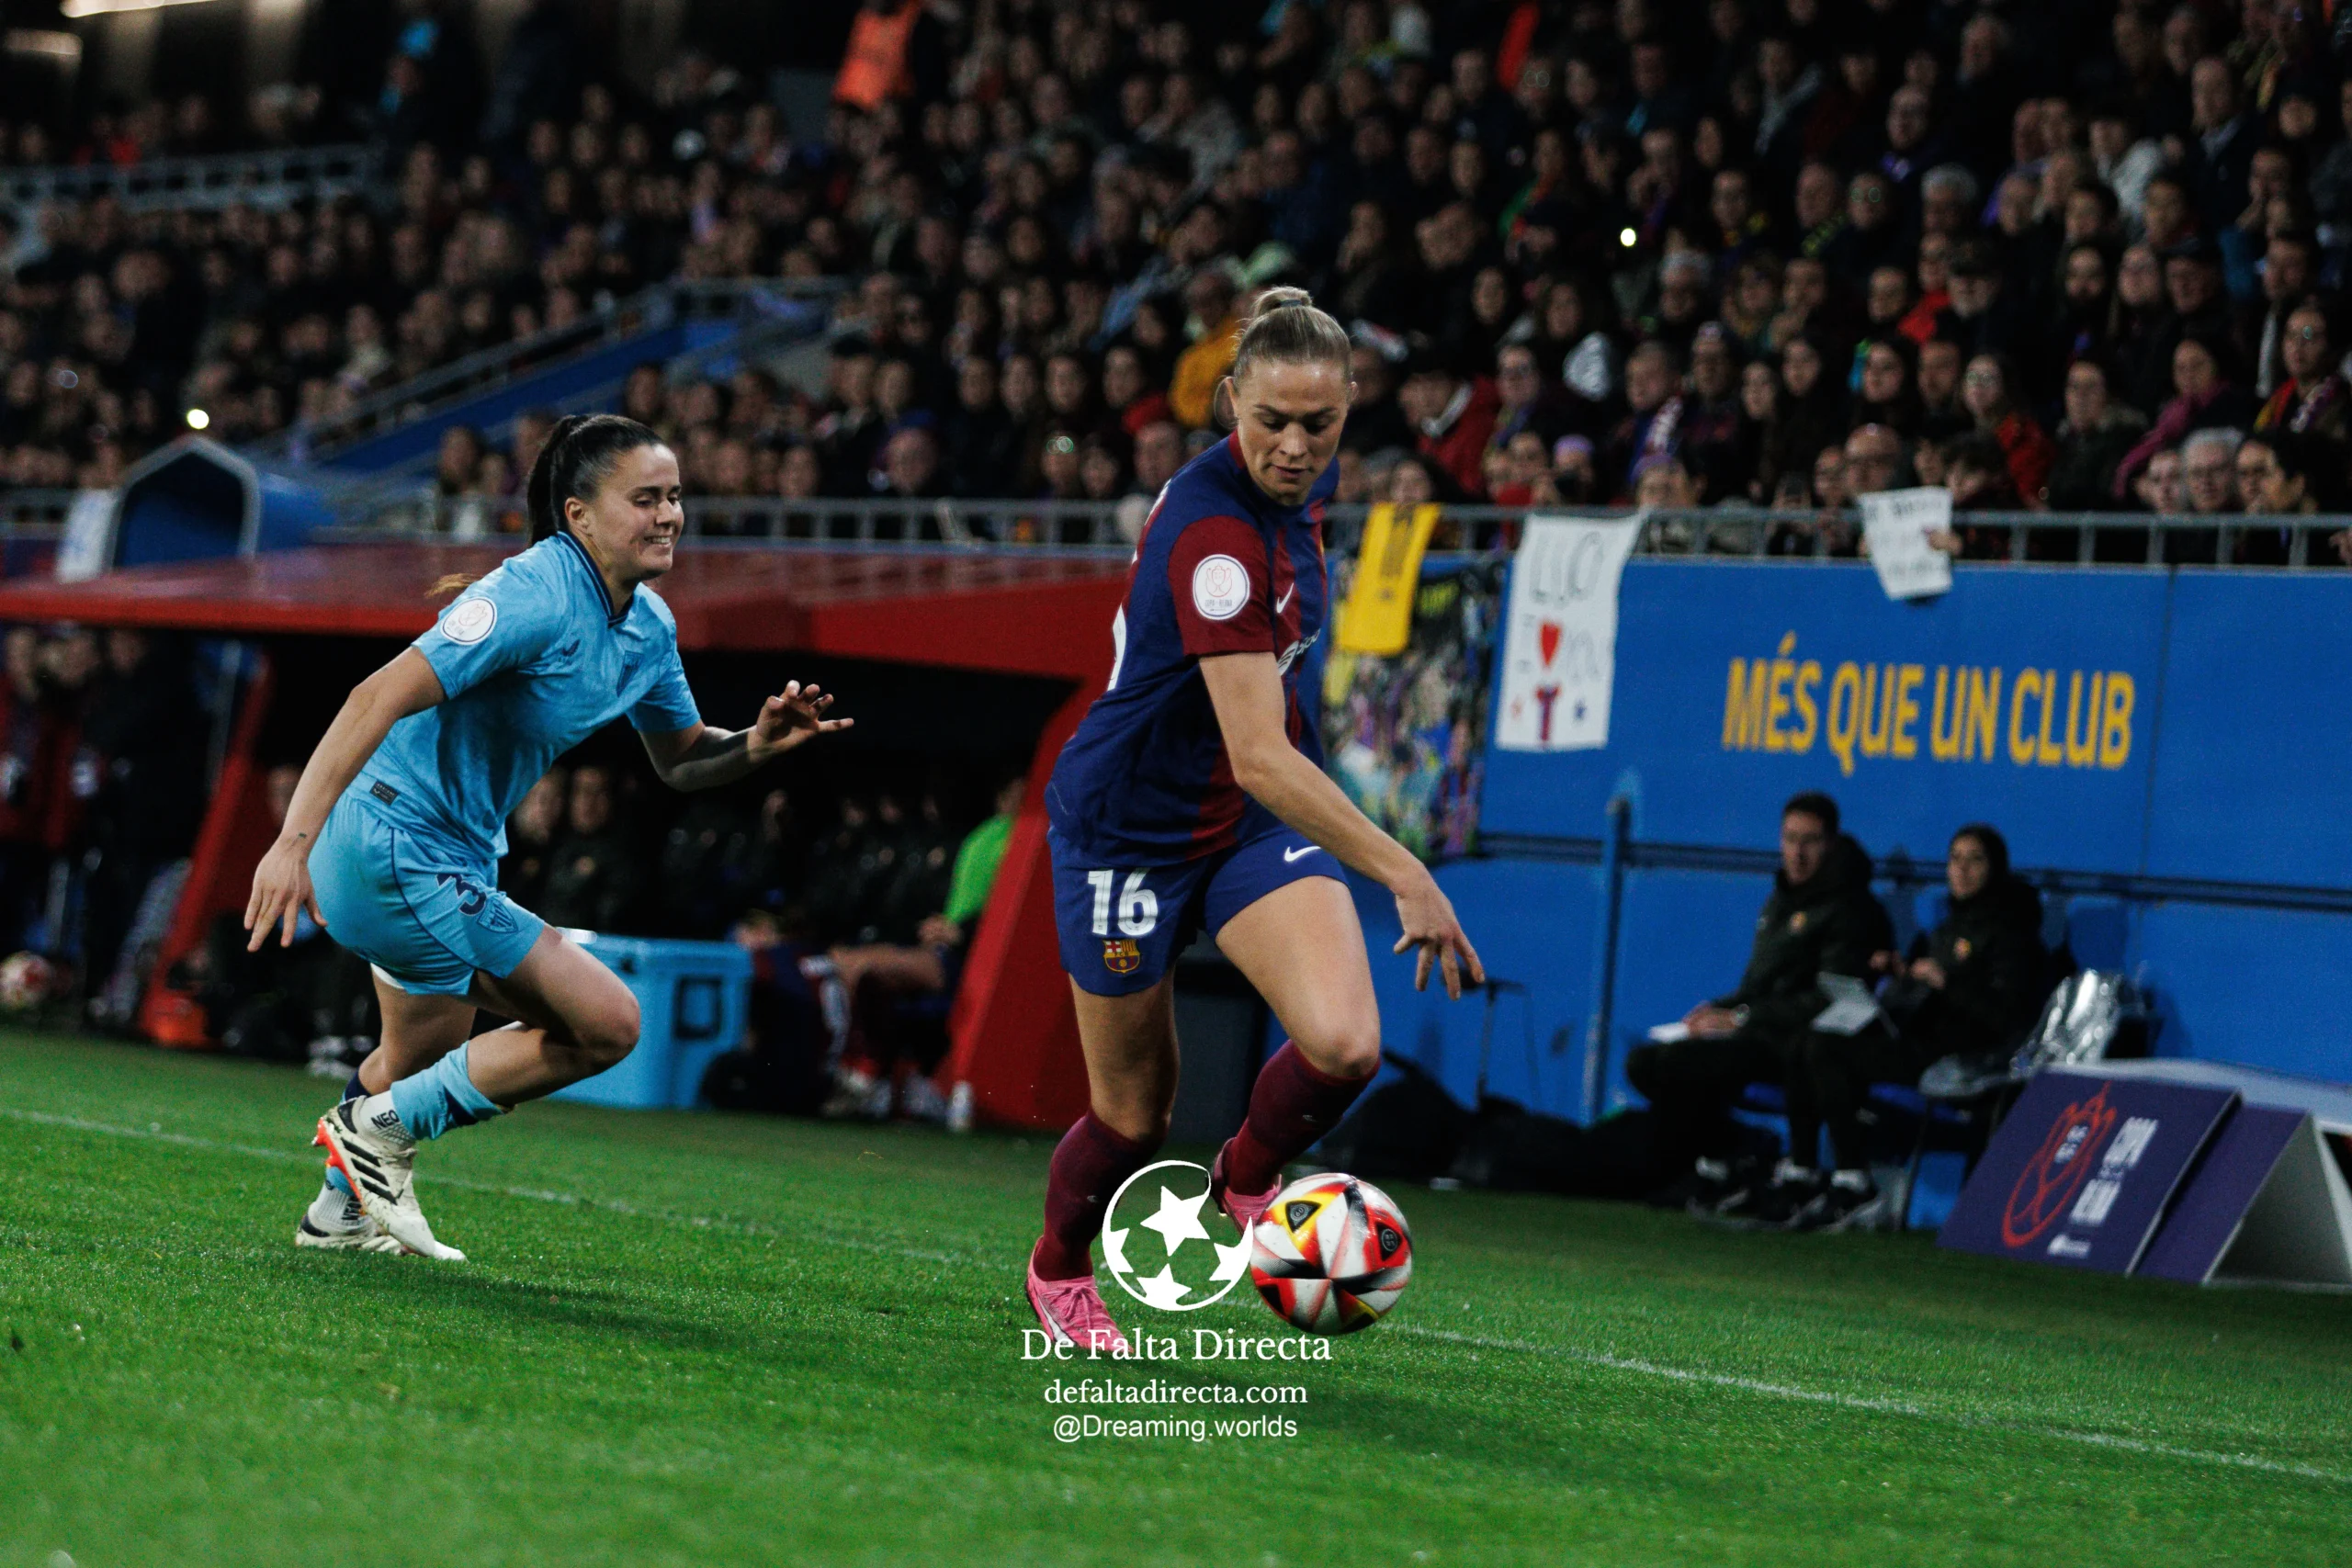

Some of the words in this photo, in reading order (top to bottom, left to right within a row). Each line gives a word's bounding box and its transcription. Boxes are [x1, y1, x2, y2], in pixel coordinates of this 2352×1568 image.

[1722, 631, 1822, 753] MÉS
[1826, 661, 1925, 774] QUE
[1930, 666, 2002, 761] UN
[2008, 669, 2135, 769] CLUB
[435, 873, 488, 917] 3
[1087, 868, 1159, 937] 16
[371, 1109, 400, 1131] NEO
